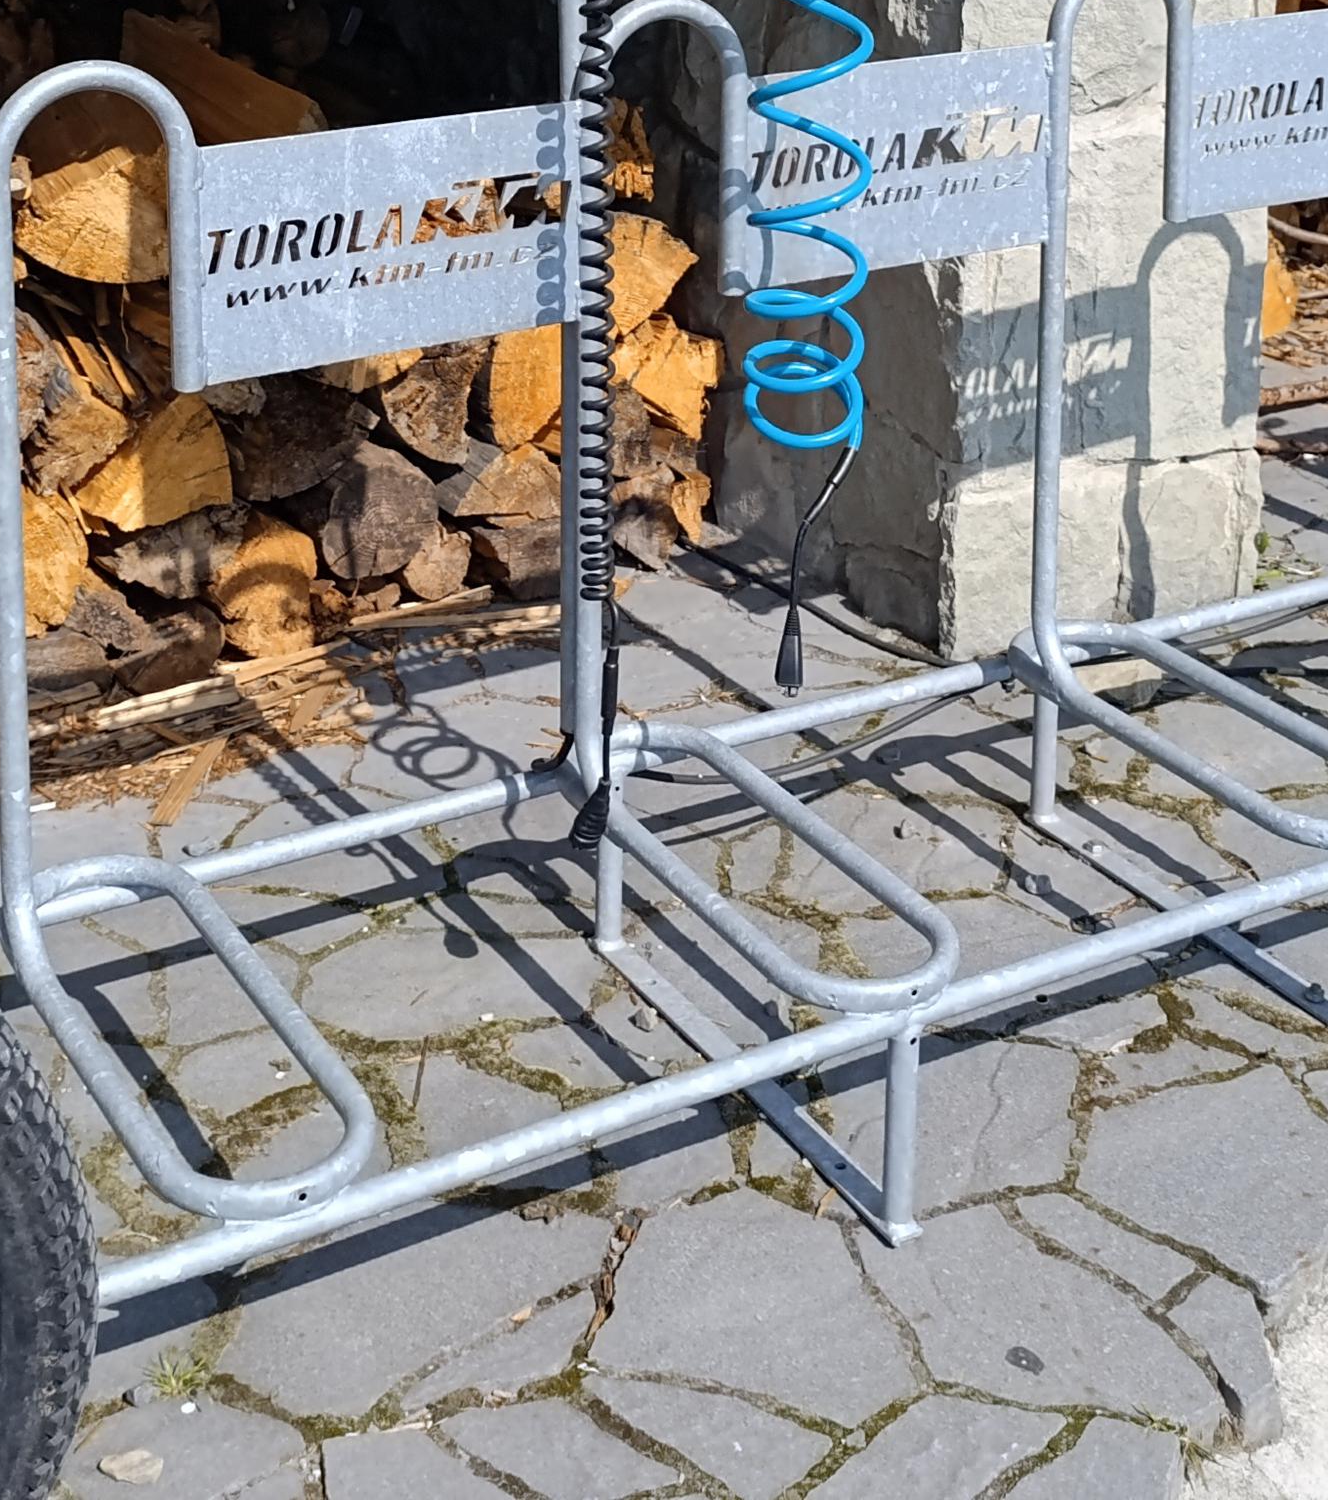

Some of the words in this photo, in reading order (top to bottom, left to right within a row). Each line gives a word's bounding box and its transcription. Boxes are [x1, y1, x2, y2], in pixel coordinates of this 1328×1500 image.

[1193, 76, 1324, 129] TOROLA
[751, 133, 906, 194] TOROLA
[912, 105, 1043, 170] KTM
[207, 204, 402, 275] TOROLA
[410, 172, 572, 245] KTM
